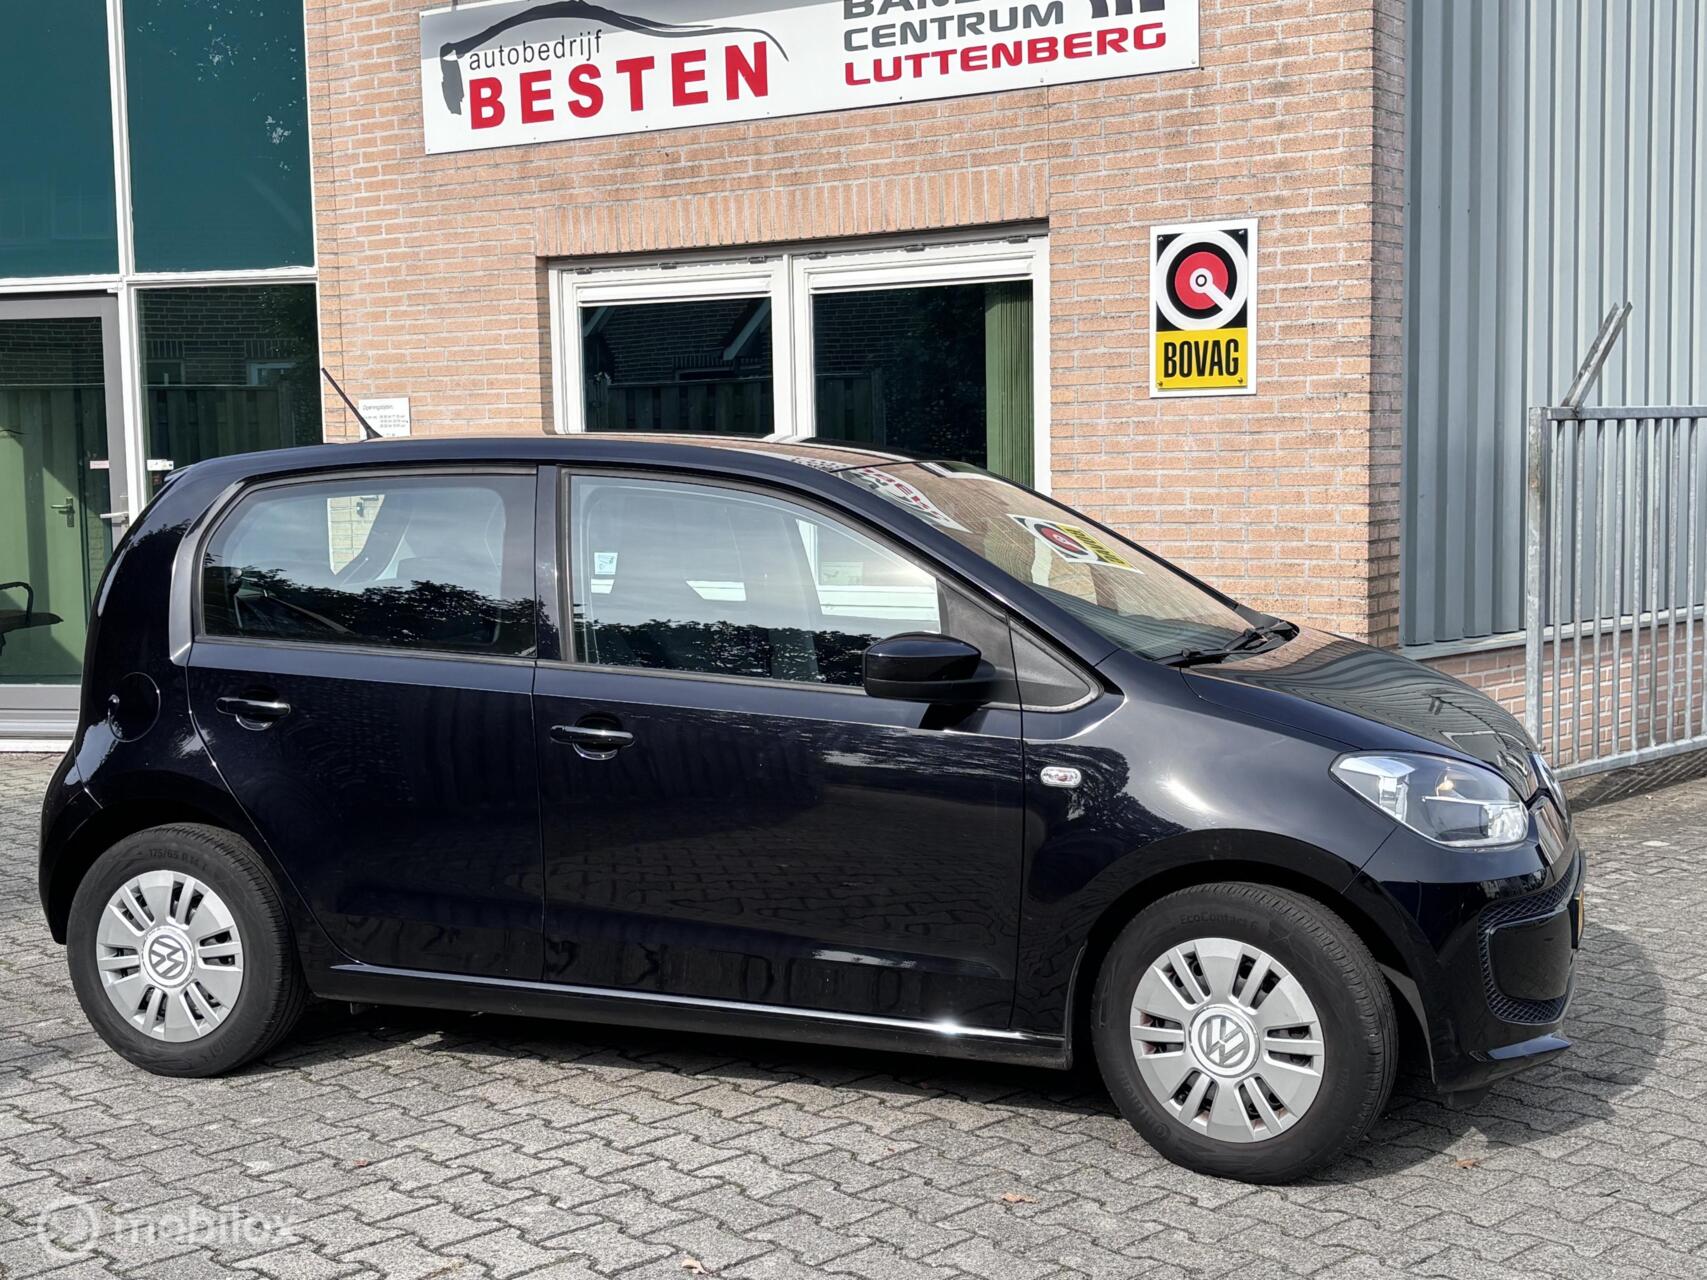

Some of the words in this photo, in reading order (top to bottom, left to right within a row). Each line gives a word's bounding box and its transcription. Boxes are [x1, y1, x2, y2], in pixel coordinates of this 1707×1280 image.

[468, 29, 603, 71] autobedrijf
[843, 0, 1064, 52] CENTRUM
[843, 22, 1167, 86] LUTTENBERG
[468, 41, 769, 130] BESTEN
[1163, 338, 1240, 379] BOVAG
